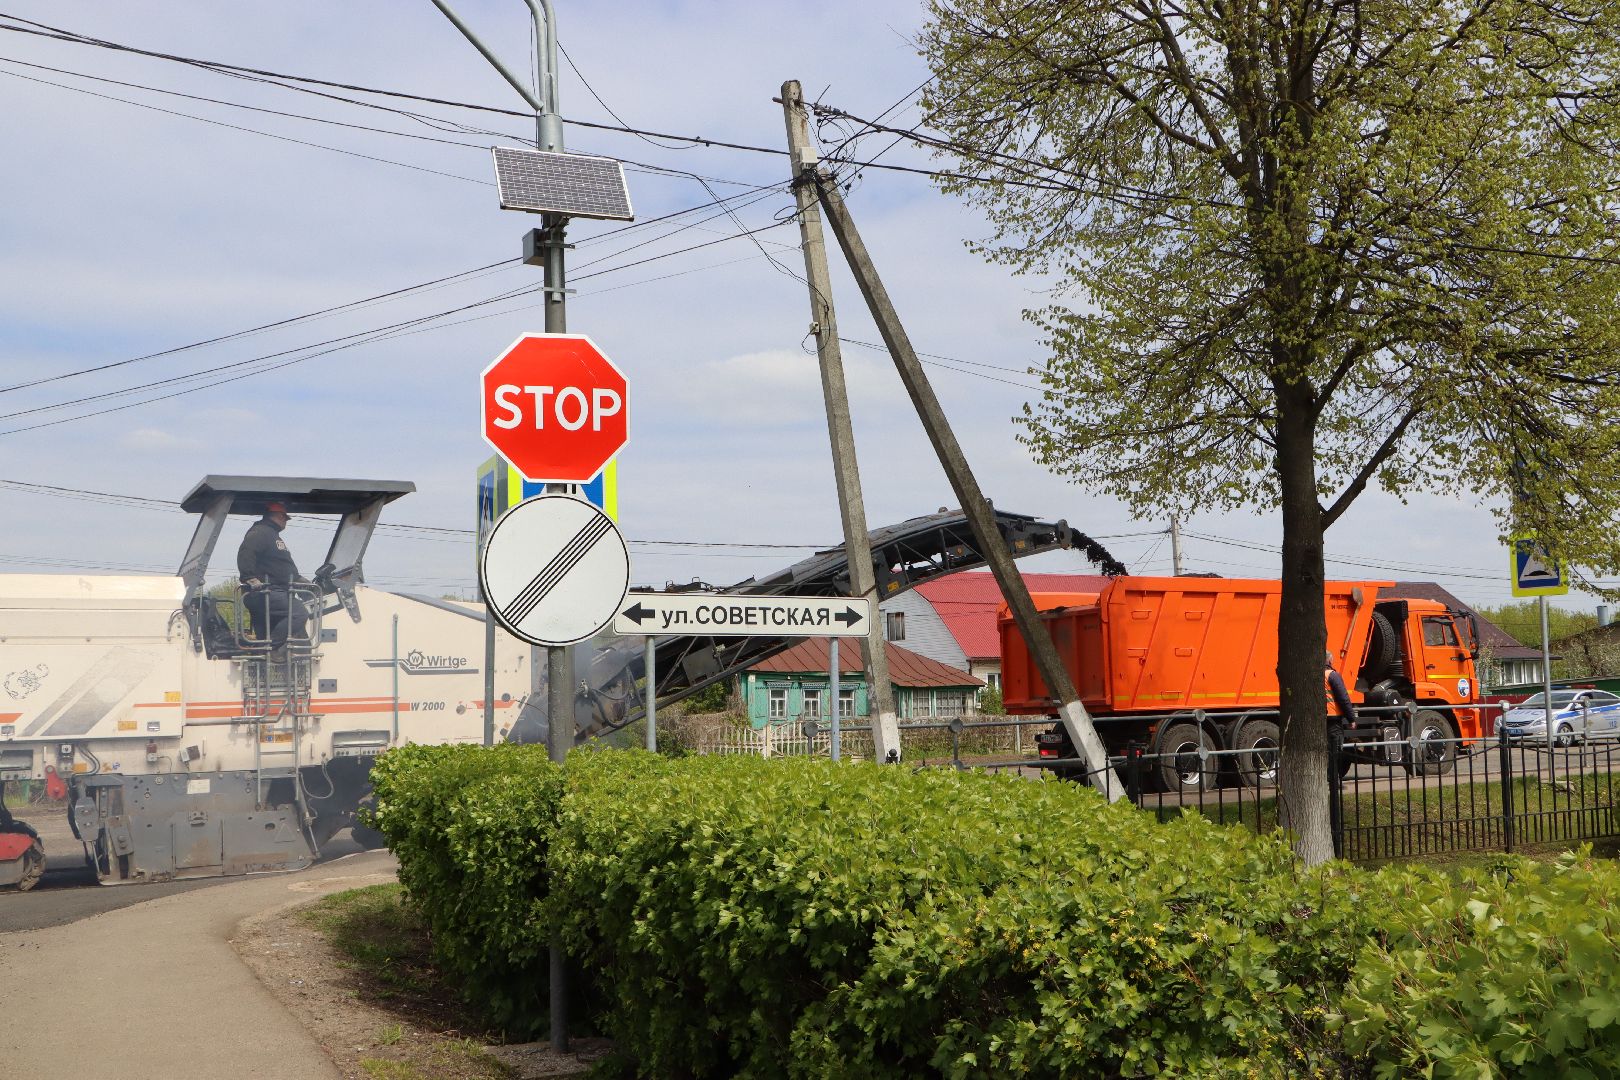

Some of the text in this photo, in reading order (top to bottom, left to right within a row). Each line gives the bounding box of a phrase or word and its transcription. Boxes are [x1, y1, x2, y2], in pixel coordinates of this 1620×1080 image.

[493, 384, 622, 432] STOP
[661, 605, 830, 629] ул.СОВЕТСКАЯ
[427, 655, 467, 668] Wirtge
[411, 702, 445, 711] W 2000
